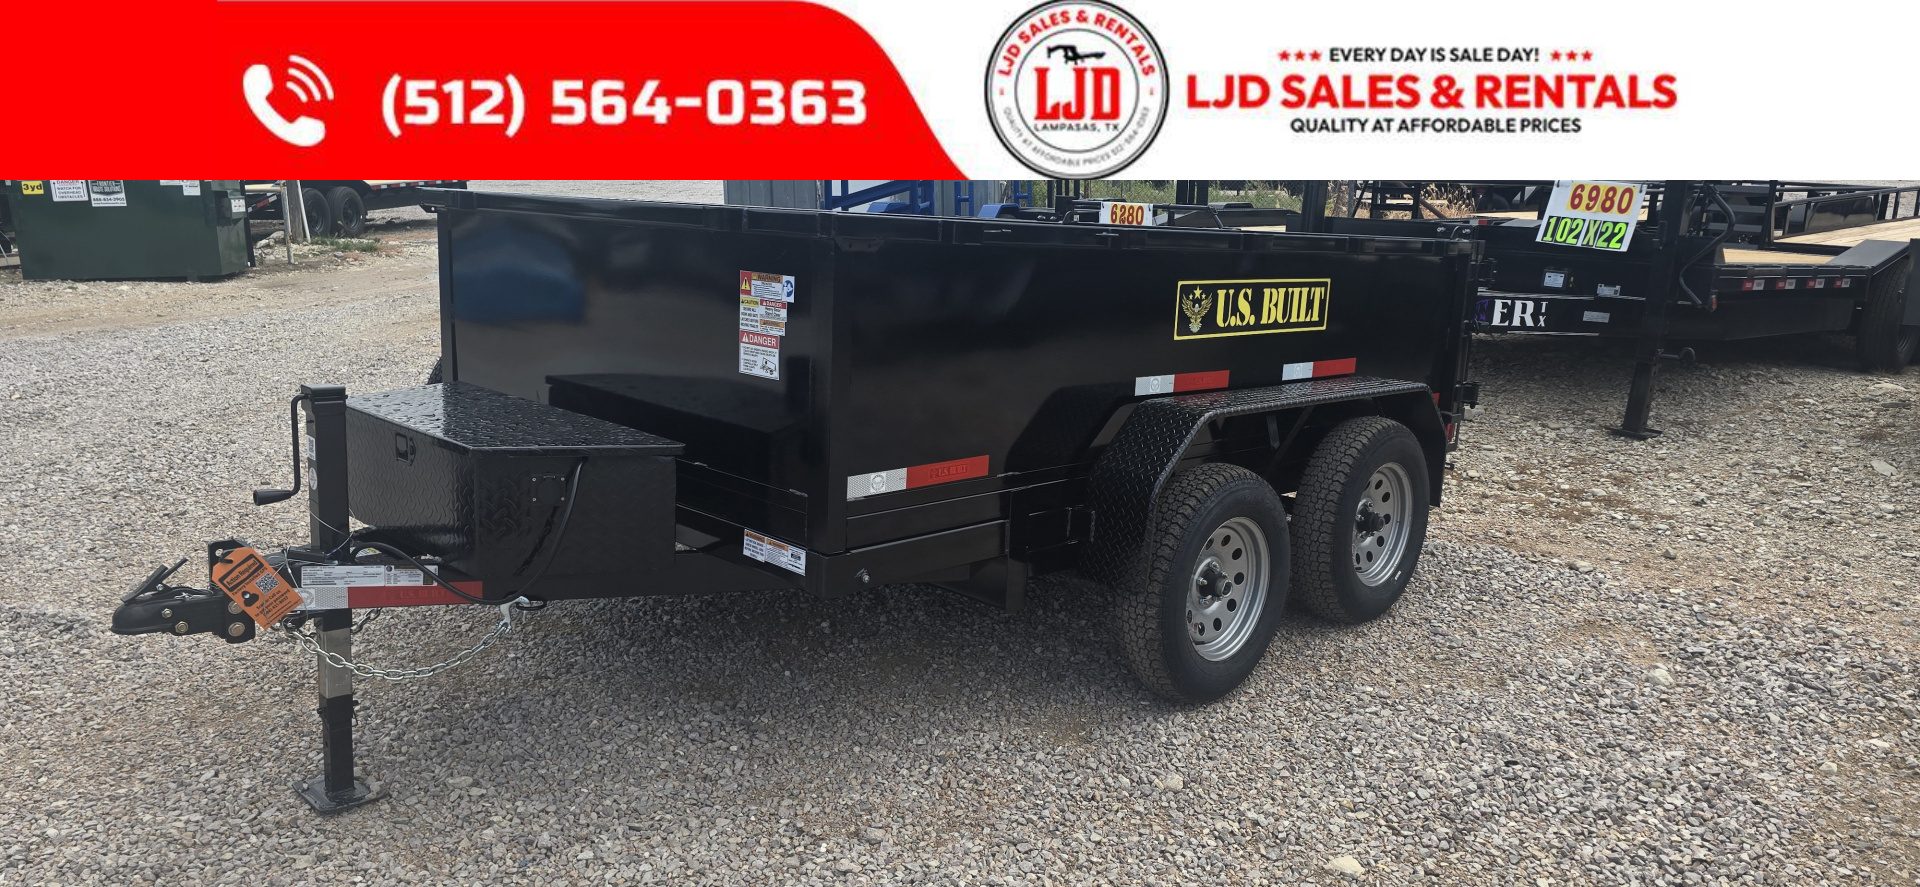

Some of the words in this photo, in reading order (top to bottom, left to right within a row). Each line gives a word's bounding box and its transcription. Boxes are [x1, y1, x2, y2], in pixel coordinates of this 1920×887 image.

[23, 183, 43, 192] 3yd
[1570, 183, 1635, 215] 6980
[1110, 203, 1145, 226] 6280
[758, 274, 781, 282] WARNING
[1216, 288, 1256, 328] U.S.
[1260, 285, 1325, 325] BUILT
[750, 334, 776, 346] DANGER
[226, 573, 242, 586] Action
[238, 560, 258, 578] Required
[245, 572, 260, 586] Installed
[259, 566, 268, 576] GPS
